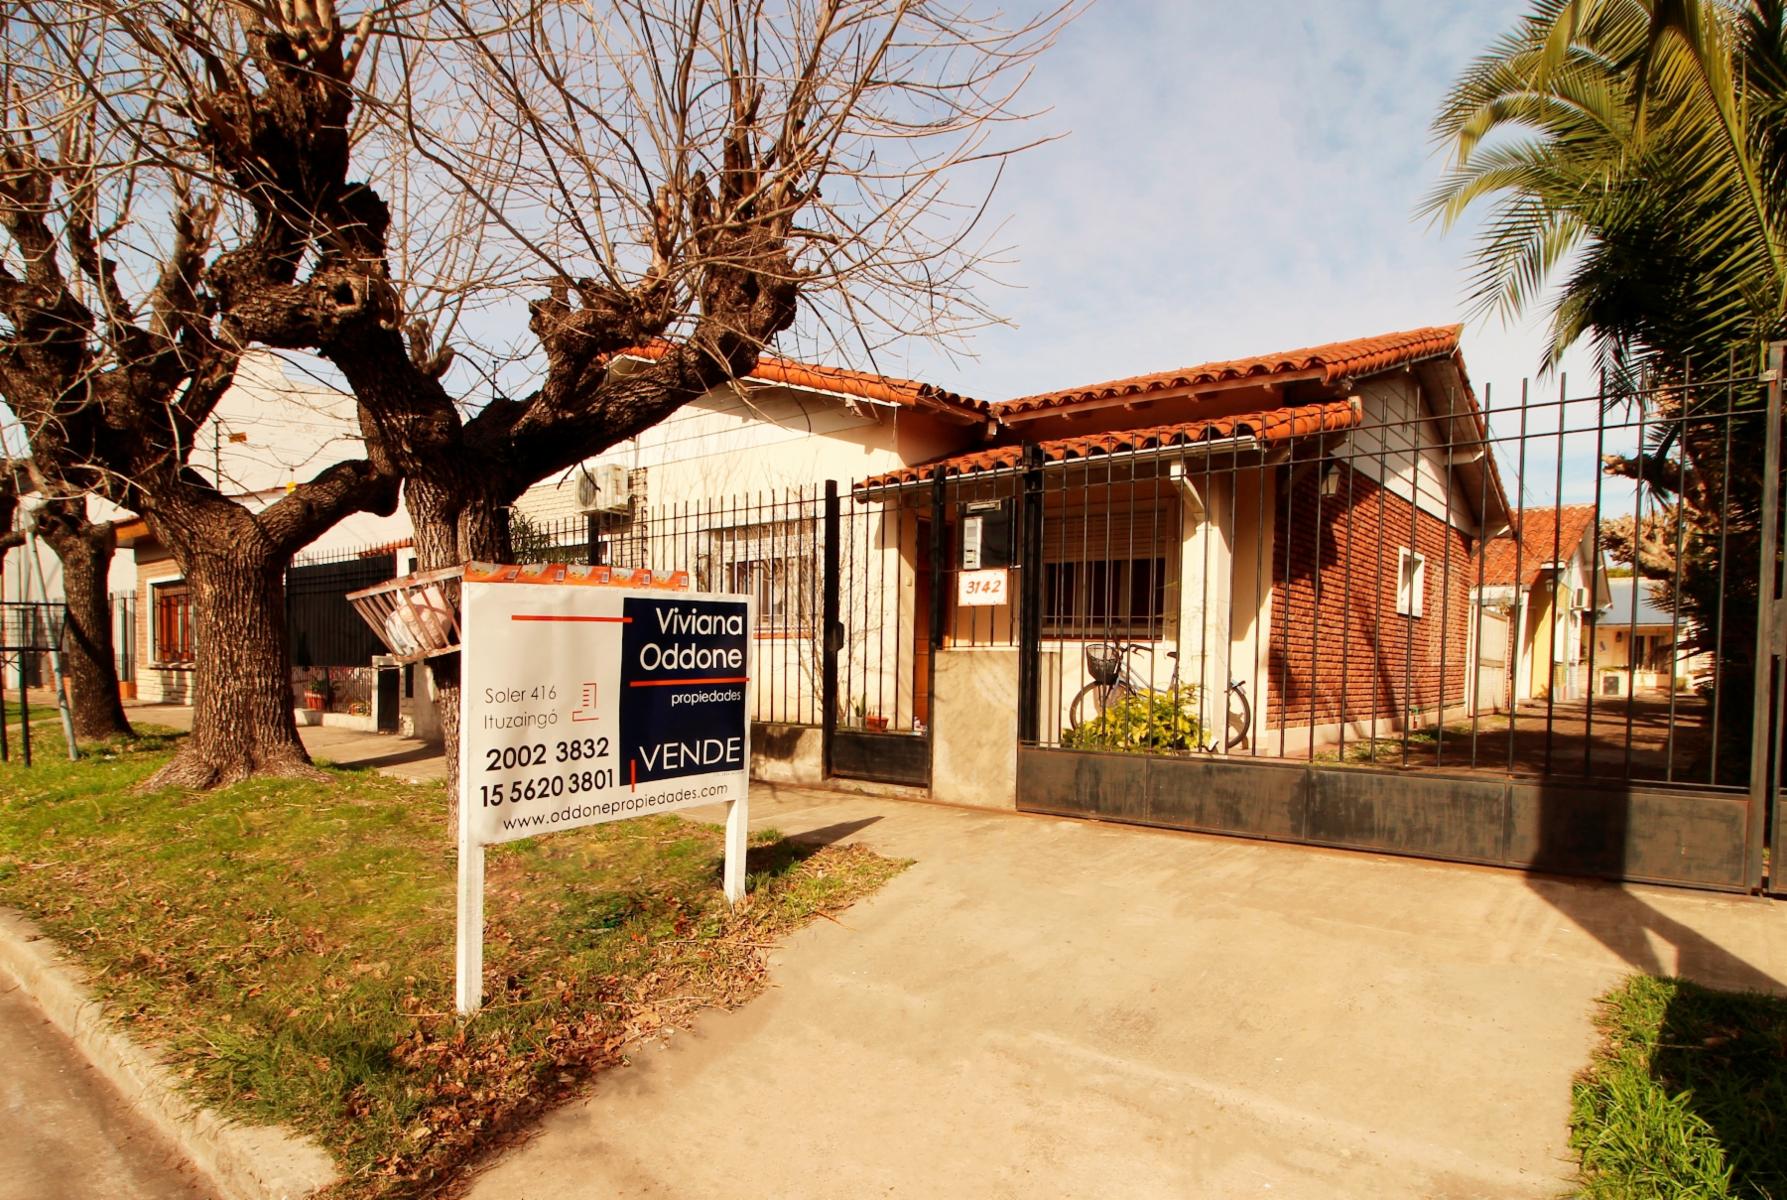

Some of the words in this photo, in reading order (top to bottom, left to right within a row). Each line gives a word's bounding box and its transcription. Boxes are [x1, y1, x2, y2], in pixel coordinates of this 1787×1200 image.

[966, 580, 1001, 594] 3142
[655, 607, 743, 636] Viviana
[639, 643, 742, 671] Oddone
[485, 688, 526, 704] Soler
[531, 685, 557, 701] 416
[671, 690, 741, 706] propiedades
[484, 710, 558, 730] Ituzaingó
[486, 744, 547, 771] 2002
[556, 737, 609, 763] 3832
[639, 737, 741, 772] VENDE
[480, 785, 504, 807] 15
[510, 777, 564, 803] 5620
[568, 769, 614, 794] 3801
[503, 783, 728, 831] www.oddonepropiedades.com
